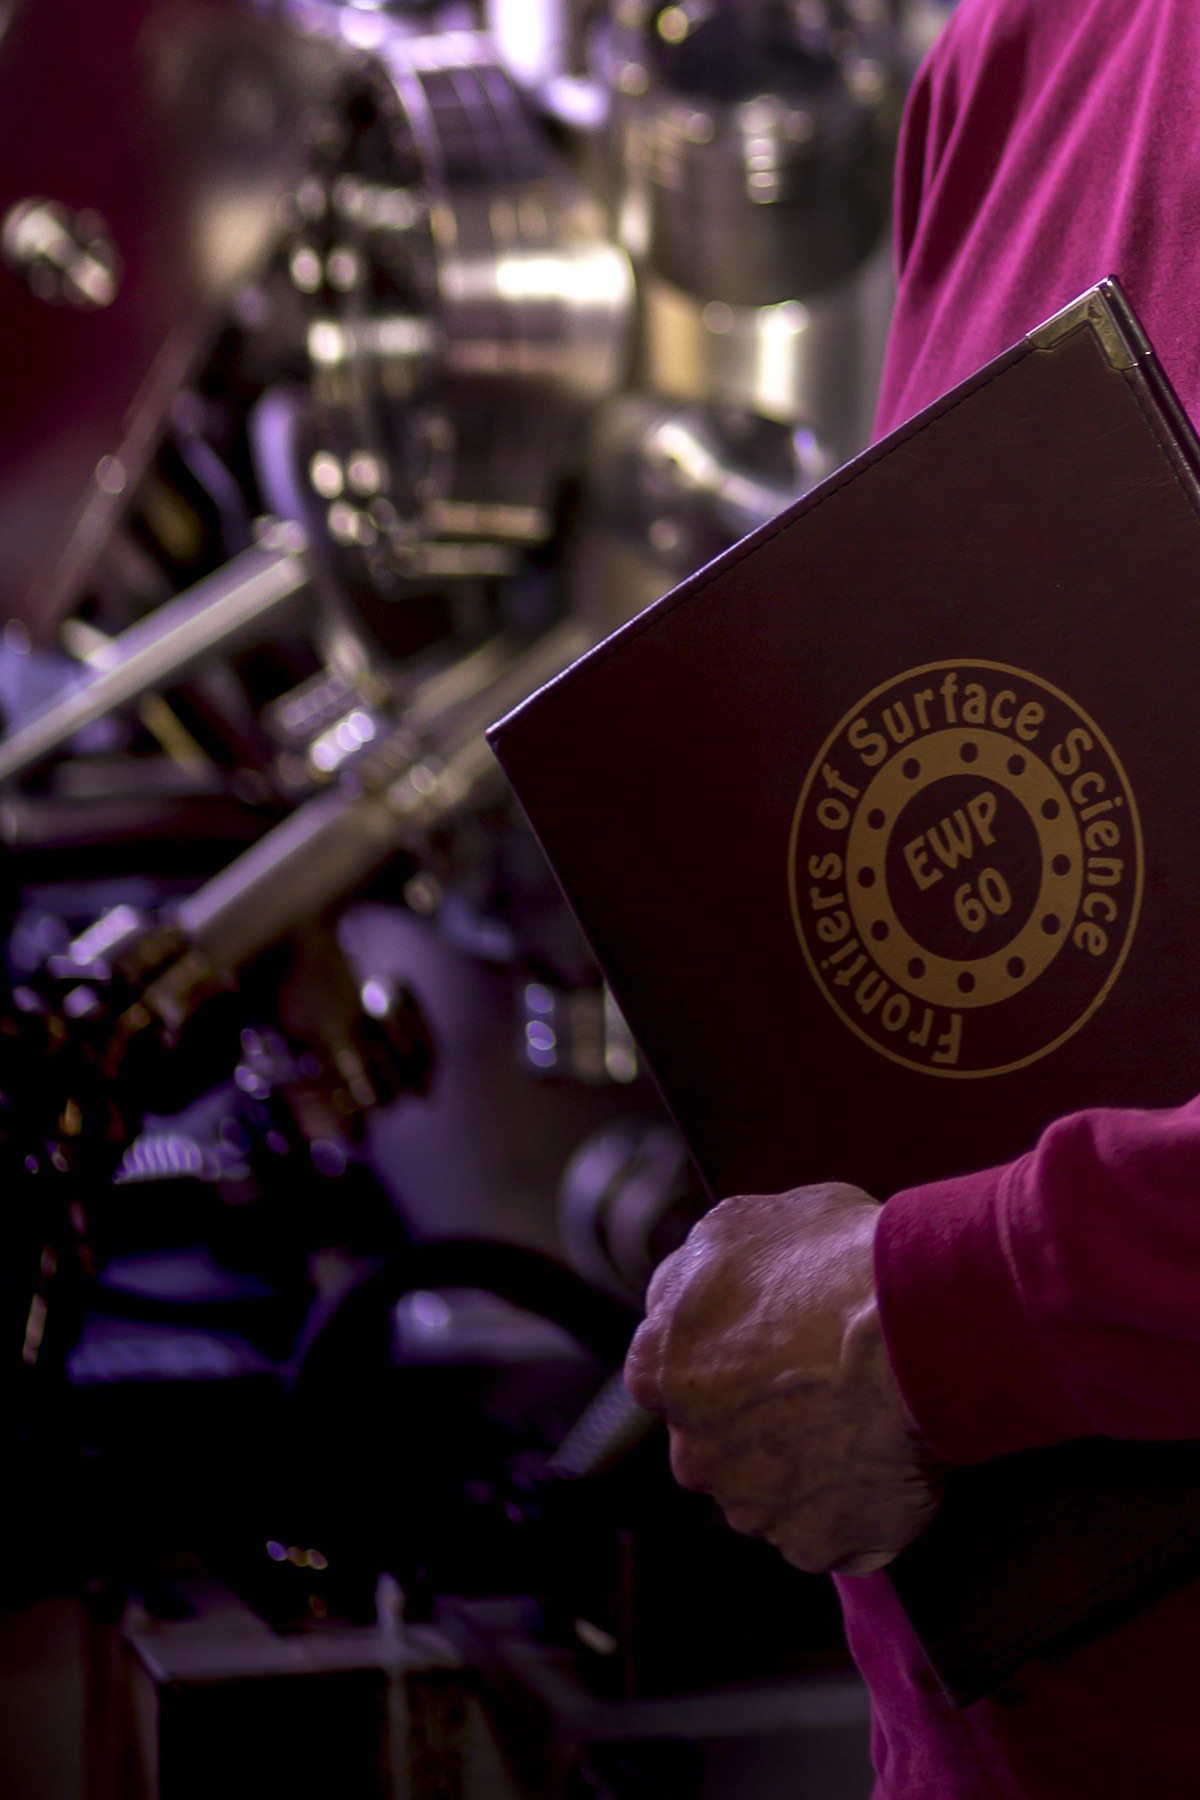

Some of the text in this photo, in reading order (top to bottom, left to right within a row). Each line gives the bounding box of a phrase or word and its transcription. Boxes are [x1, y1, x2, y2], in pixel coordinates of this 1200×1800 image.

[808, 672, 1125, 1065] Frontiers of Surface Science
[902, 791, 998, 890] EWP
[953, 867, 1012, 932] 60
